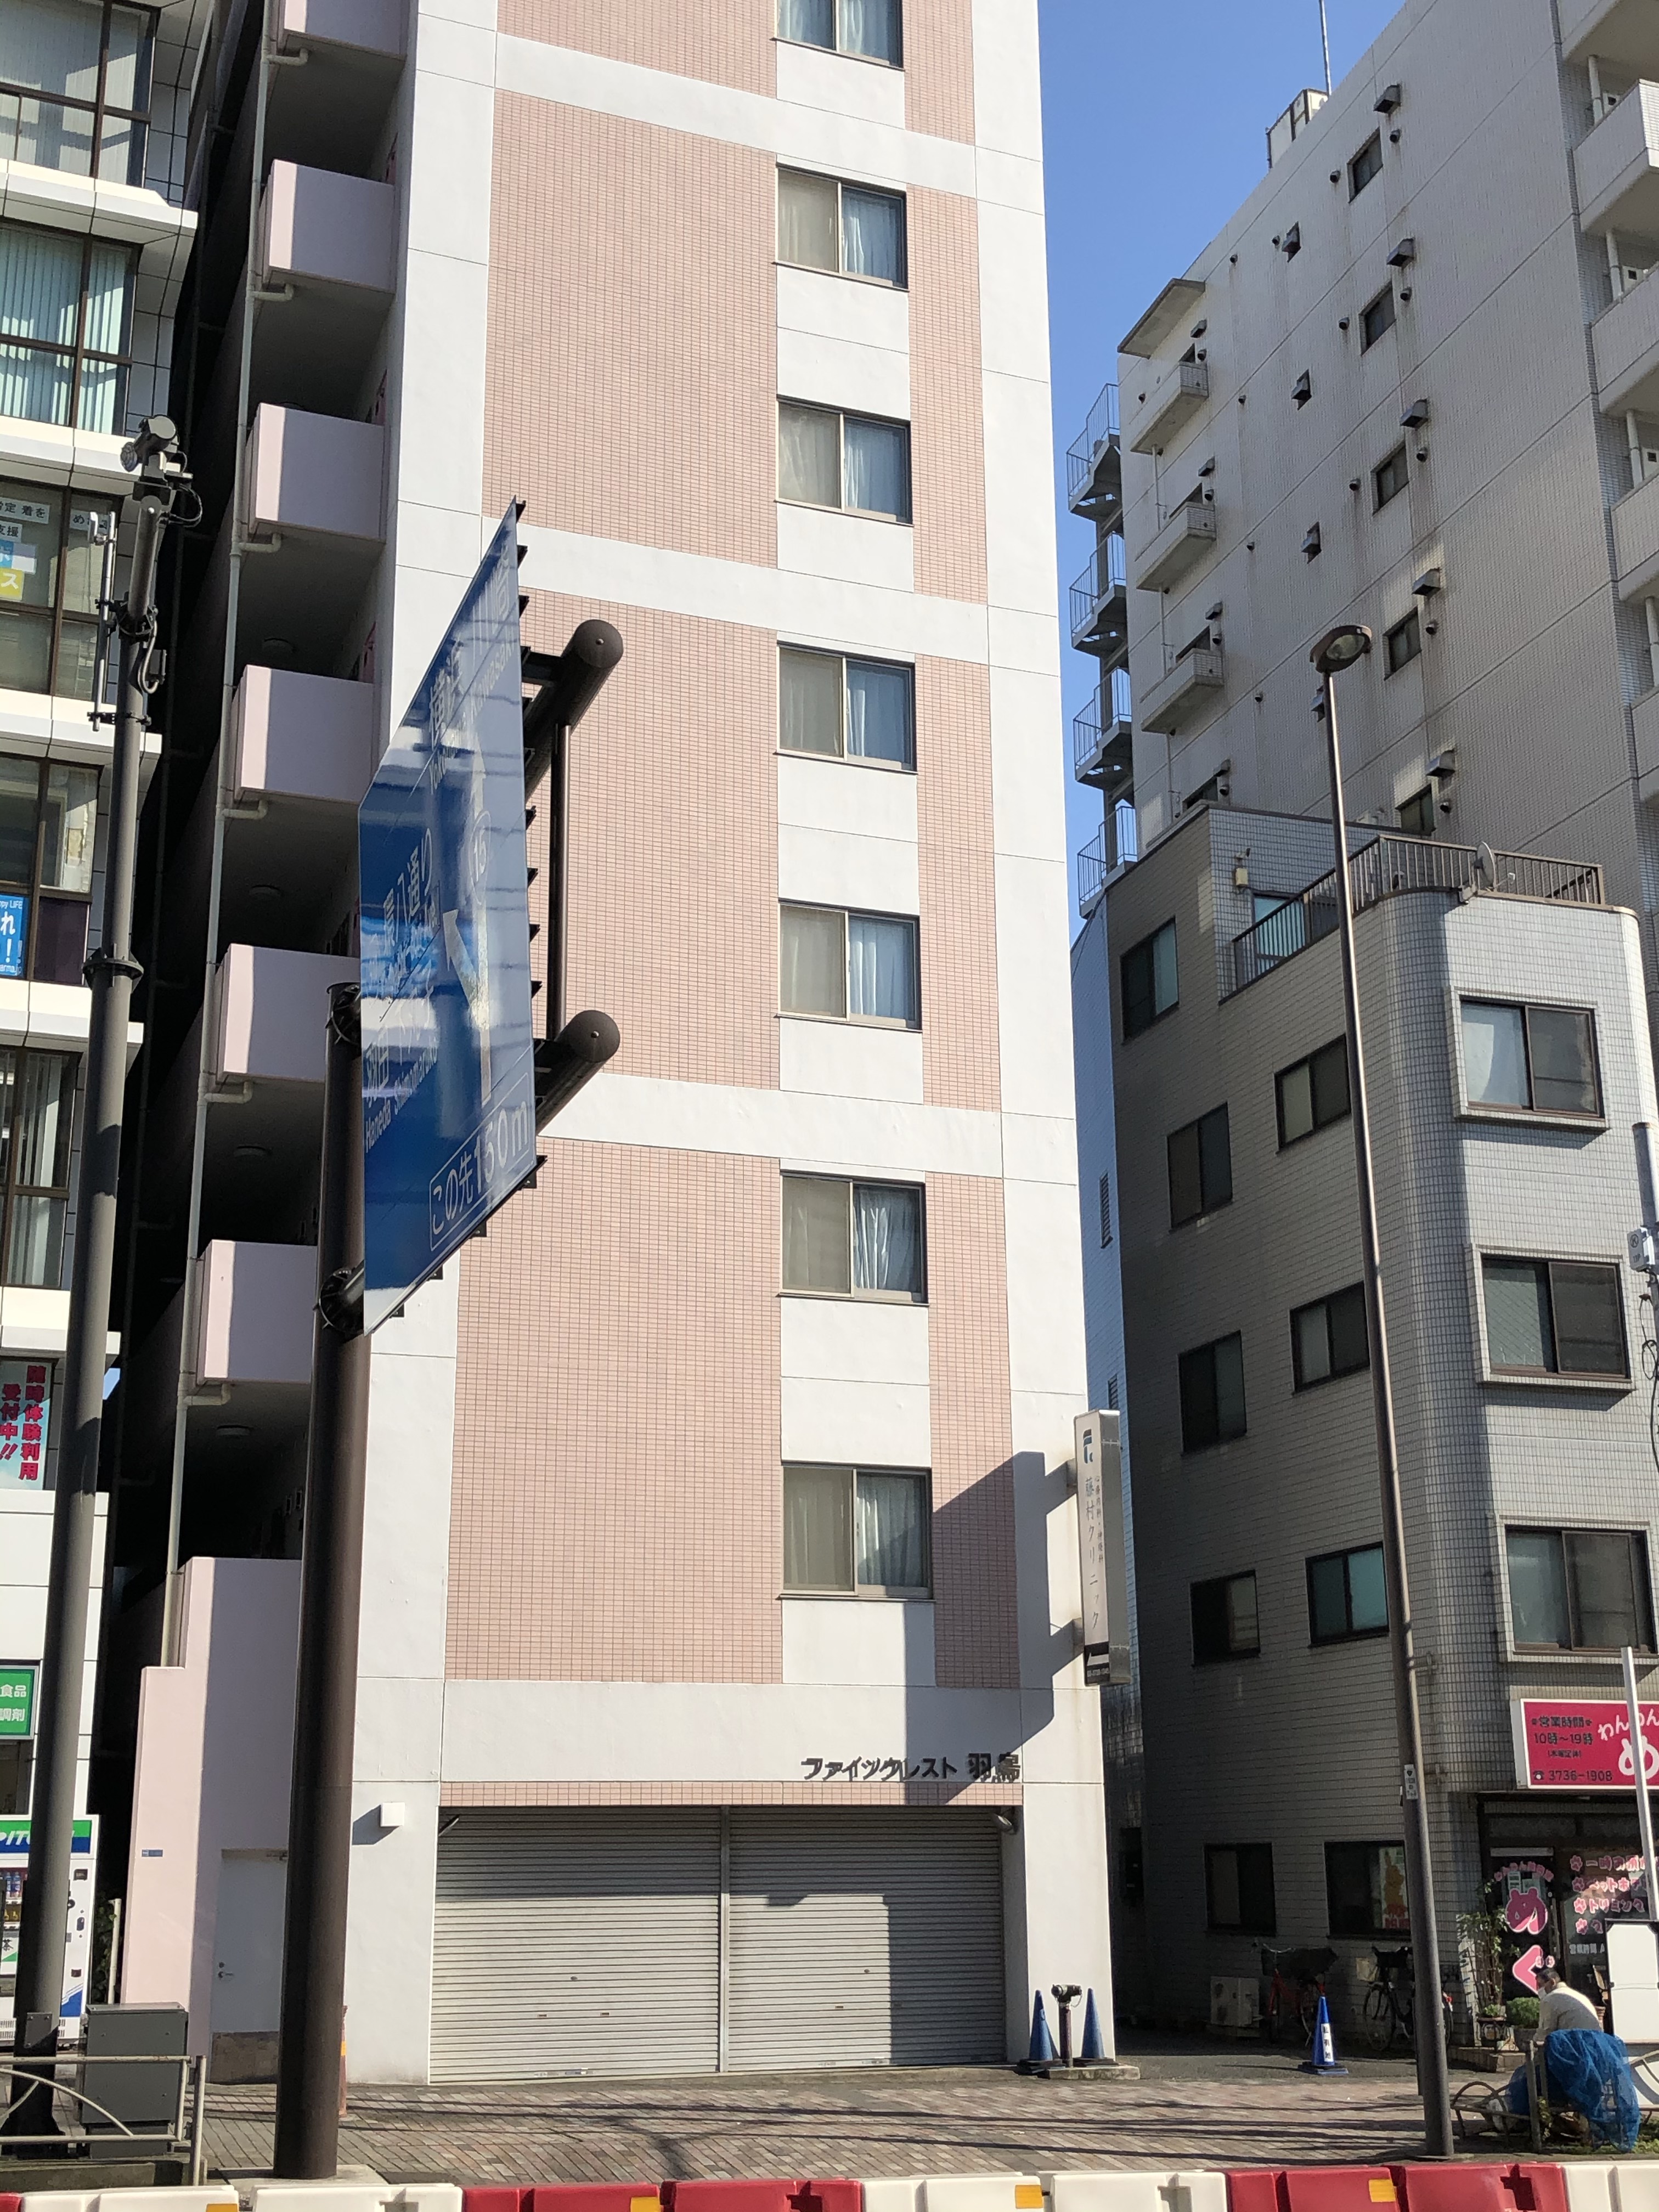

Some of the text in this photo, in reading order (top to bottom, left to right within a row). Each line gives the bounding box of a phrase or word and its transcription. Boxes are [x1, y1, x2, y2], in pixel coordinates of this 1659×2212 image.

[429, 543, 511, 752] 横浜 川崎
[474, 825, 487, 882] 15
[366, 1097, 391, 1153] Haneda
